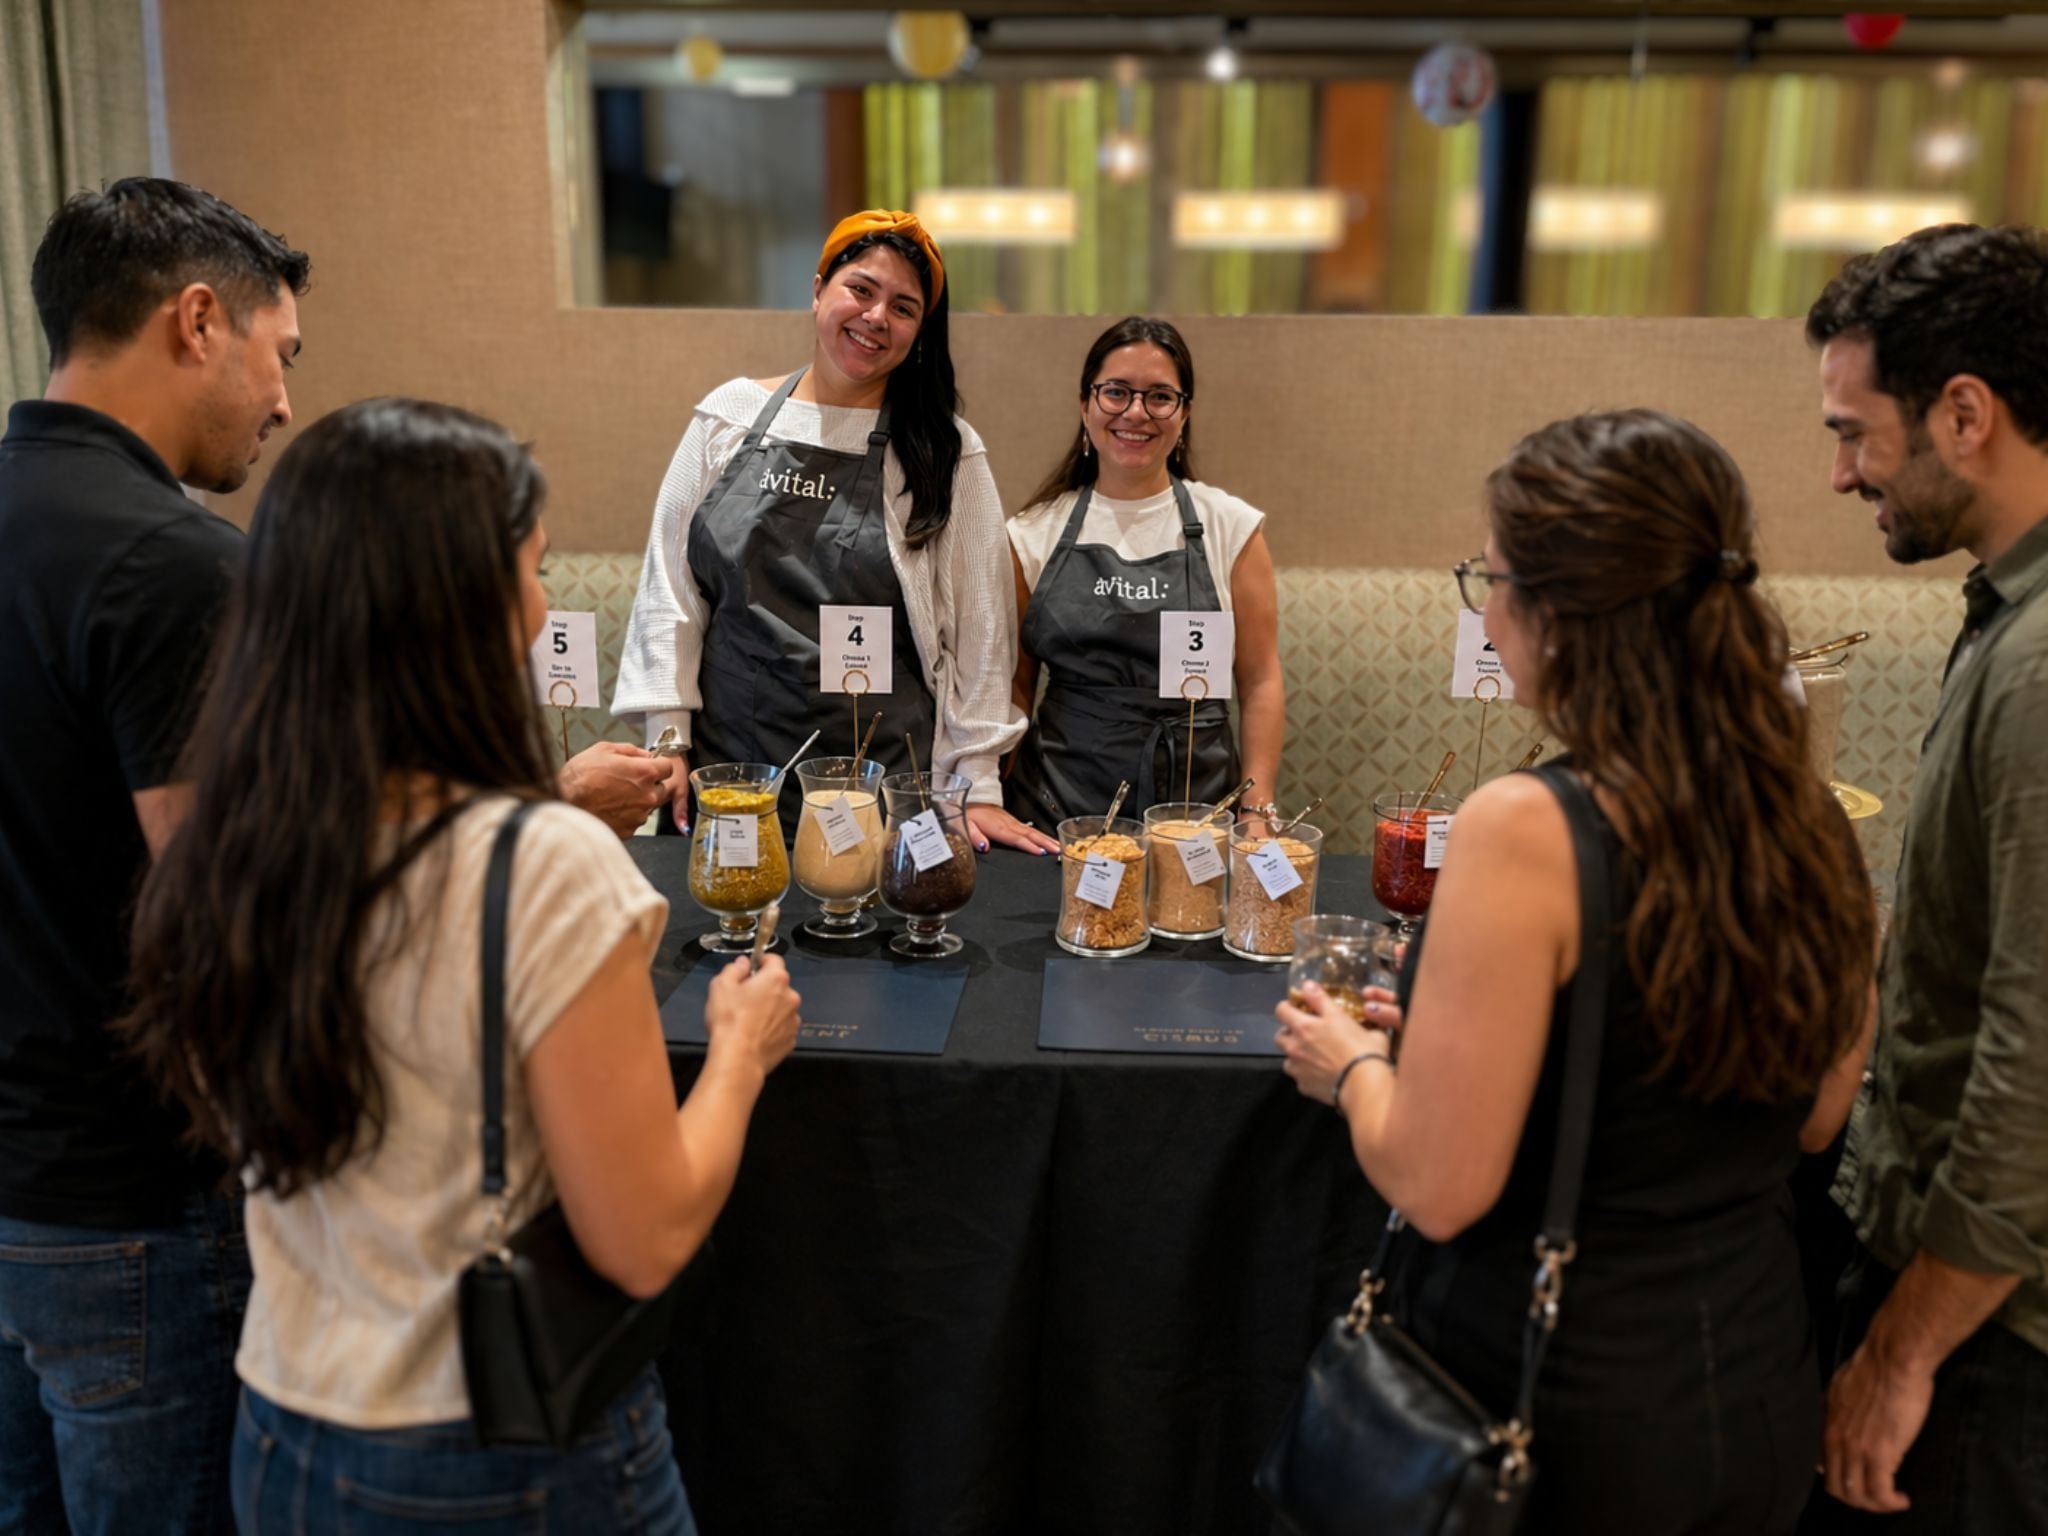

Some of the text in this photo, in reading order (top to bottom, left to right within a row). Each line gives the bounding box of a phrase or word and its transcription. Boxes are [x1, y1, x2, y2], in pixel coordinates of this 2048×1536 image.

[553, 632, 568, 654] 5
[847, 625, 864, 646] 4
[1188, 630, 1204, 652] 3
